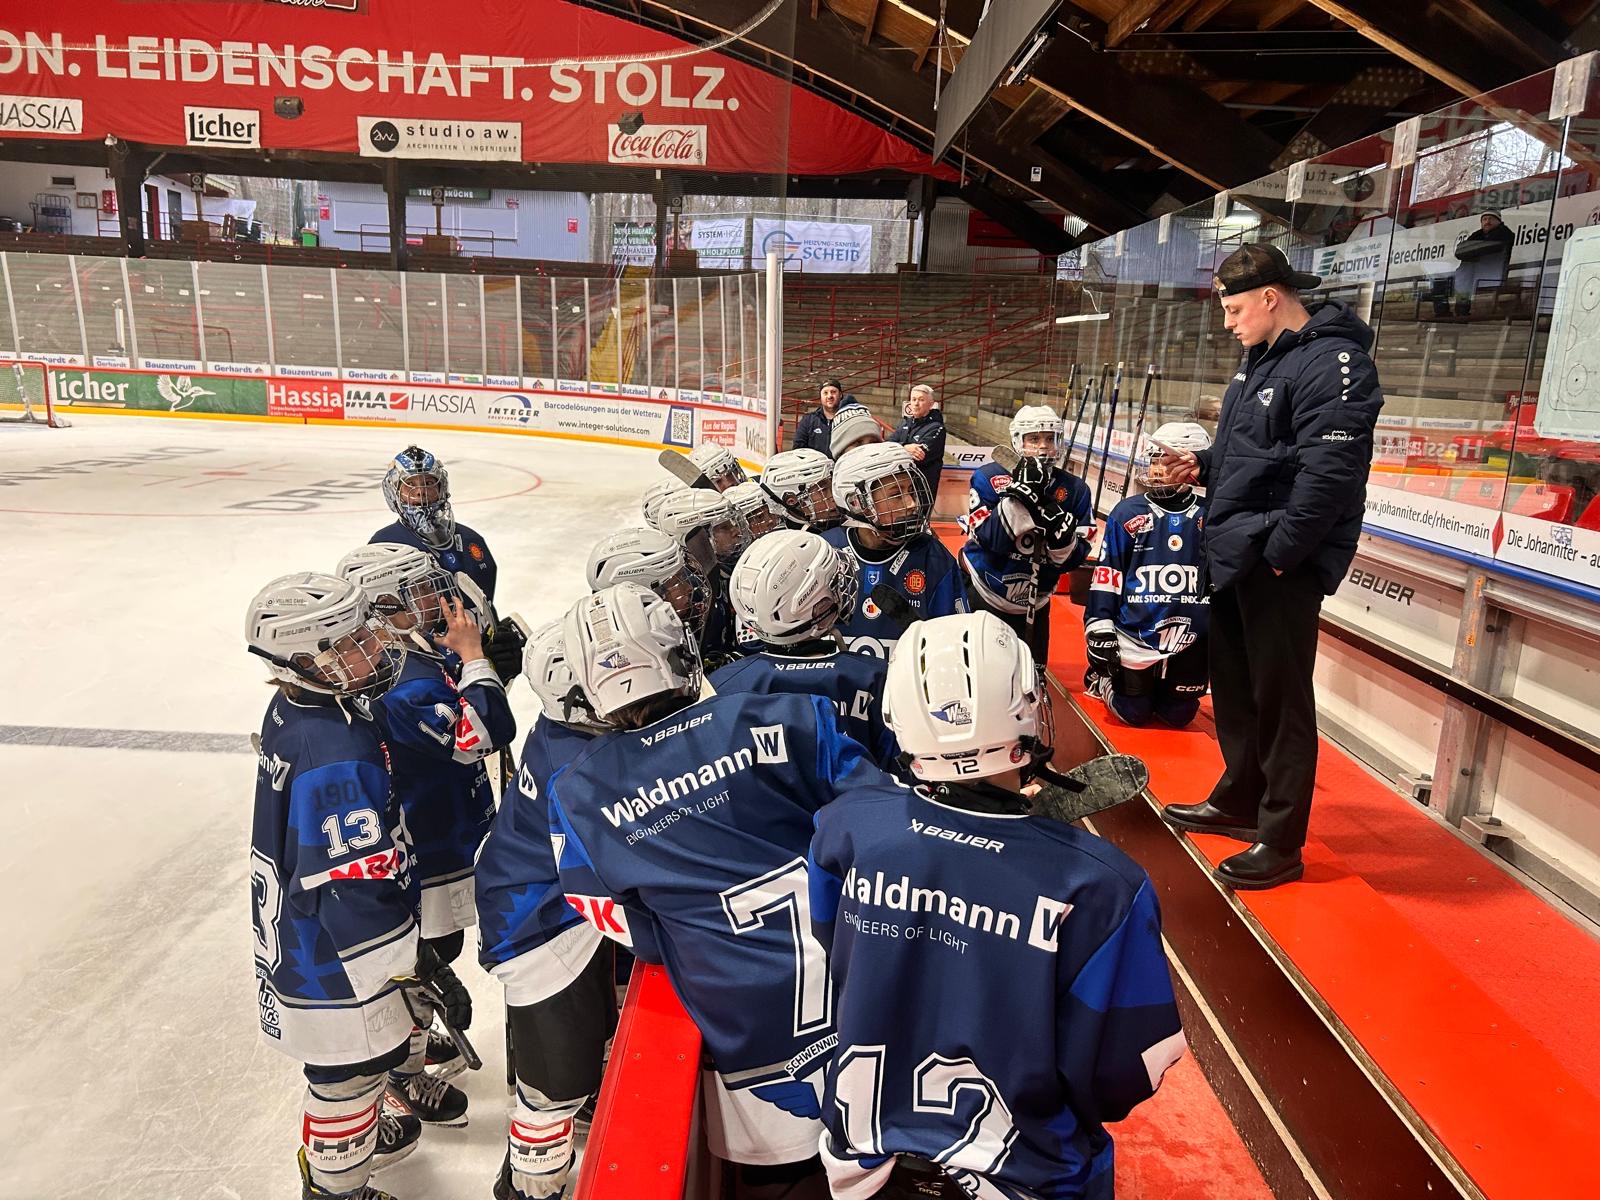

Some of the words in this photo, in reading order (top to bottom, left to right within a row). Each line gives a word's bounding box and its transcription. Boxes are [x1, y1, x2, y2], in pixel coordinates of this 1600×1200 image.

[95, 34, 533, 101] LEIDENSCHAFT.
[549, 62, 740, 111] STOLZ.
[189, 112, 256, 142] Licher
[406, 124, 475, 139] studio
[1330, 254, 1381, 275] ADDITIVE
[145, 361, 196, 371] Bauzentrum
[214, 364, 253, 374] Gerhardt
[280, 367, 333, 377] Bauzentrum
[349, 370, 388, 380] Gerhardt
[487, 378, 519, 387] Butzbach
[269, 384, 343, 408] Hassia
[346, 390, 388, 409] IMA
[411, 393, 476, 415] HASSIA
[488, 407, 540, 417] INTEGER
[544, 401, 606, 415] Barcodelösungen
[607, 407, 619, 415] aus
[620, 406, 631, 415] der
[632, 408, 662, 419] Wetterau
[558, 420, 650, 436] www.integer-solutions.com
[1507, 529, 1523, 548] Die
[1524, 533, 1579, 562] Johanniter
[1134, 563, 1199, 594] STOR
[1349, 568, 1416, 606] BAUER
[1144, 594, 1172, 604] STORZ
[785, 661, 836, 671] BAUER
[620, 678, 632, 694] 7
[1175, 684, 1205, 692] CCM
[654, 712, 713, 743] BAUER
[952, 759, 980, 775] 12
[601, 747, 753, 829] Waldmann
[697, 790, 731, 815] LIGHT
[321, 808, 382, 859] 13
[923, 824, 1006, 854] BAUER
[719, 856, 832, 1038] 7
[904, 925, 925, 940] OF
[929, 927, 969, 955] LIGHT
[835, 1044, 1020, 1176] 12
